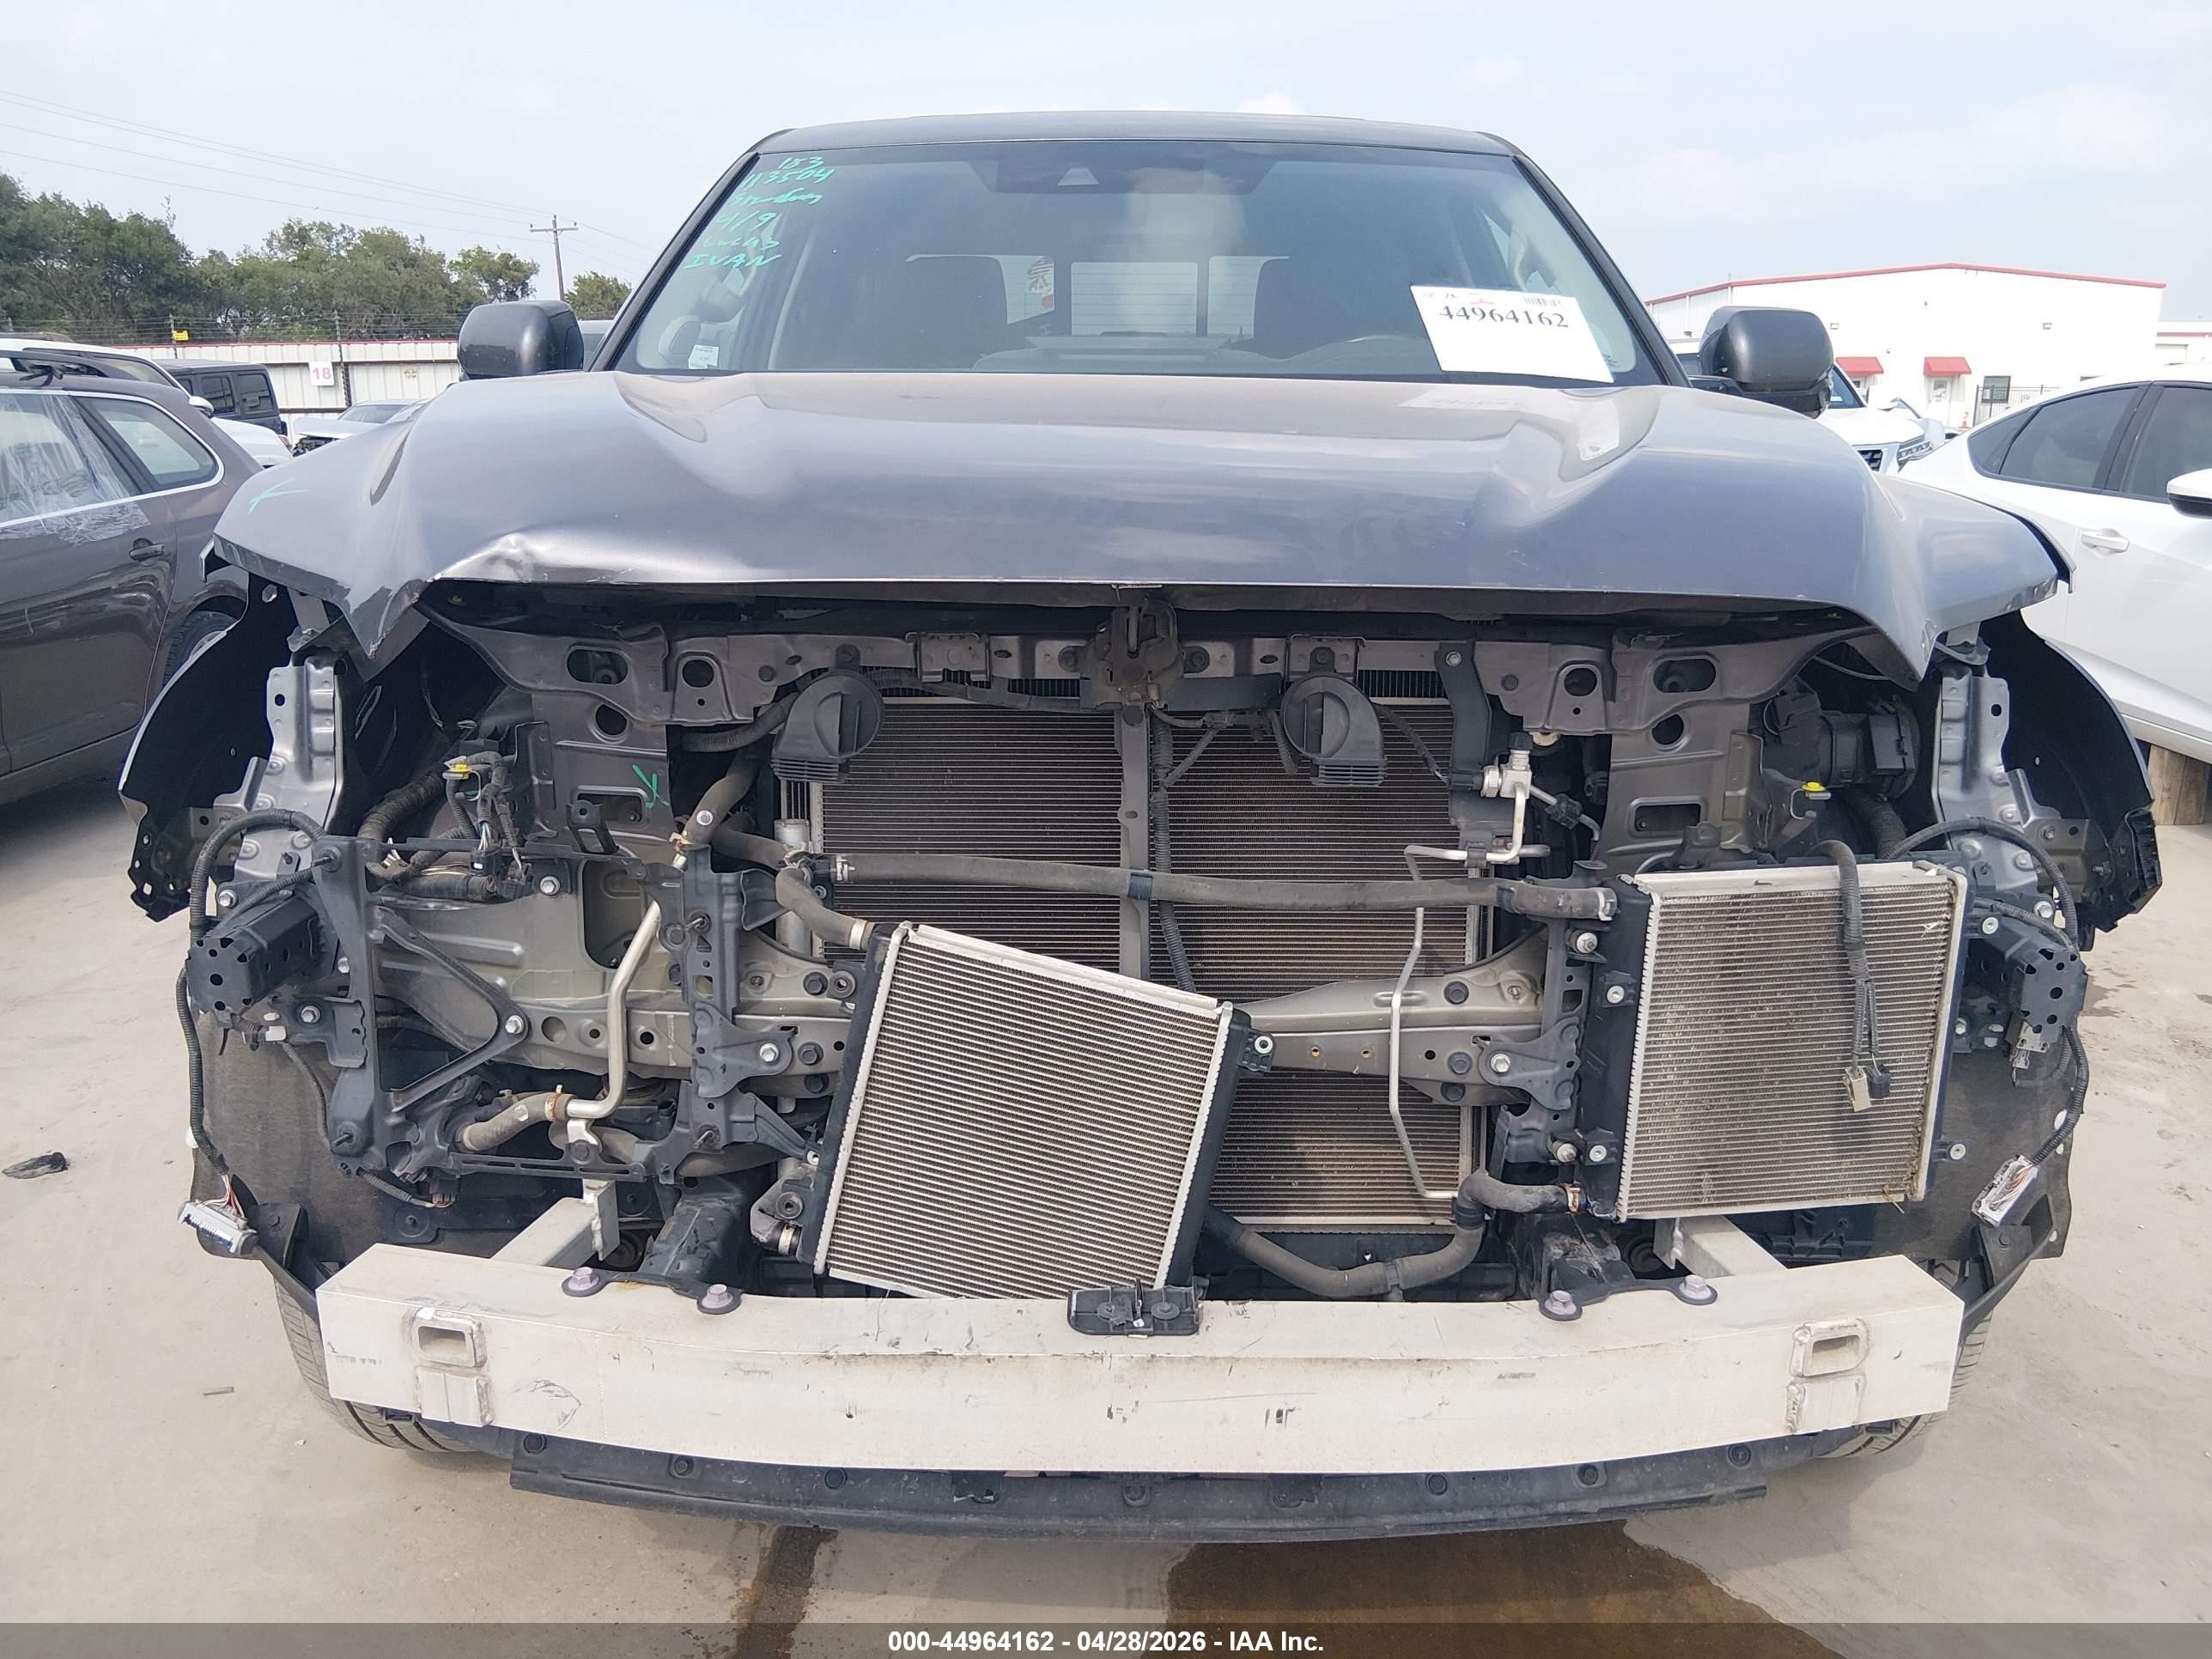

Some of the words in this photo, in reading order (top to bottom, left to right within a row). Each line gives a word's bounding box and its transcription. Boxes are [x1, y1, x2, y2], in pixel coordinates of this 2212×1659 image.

[684, 253, 782, 268] IVAN
[1439, 305, 1569, 328] 44964162
[313, 367, 331, 380] 18
